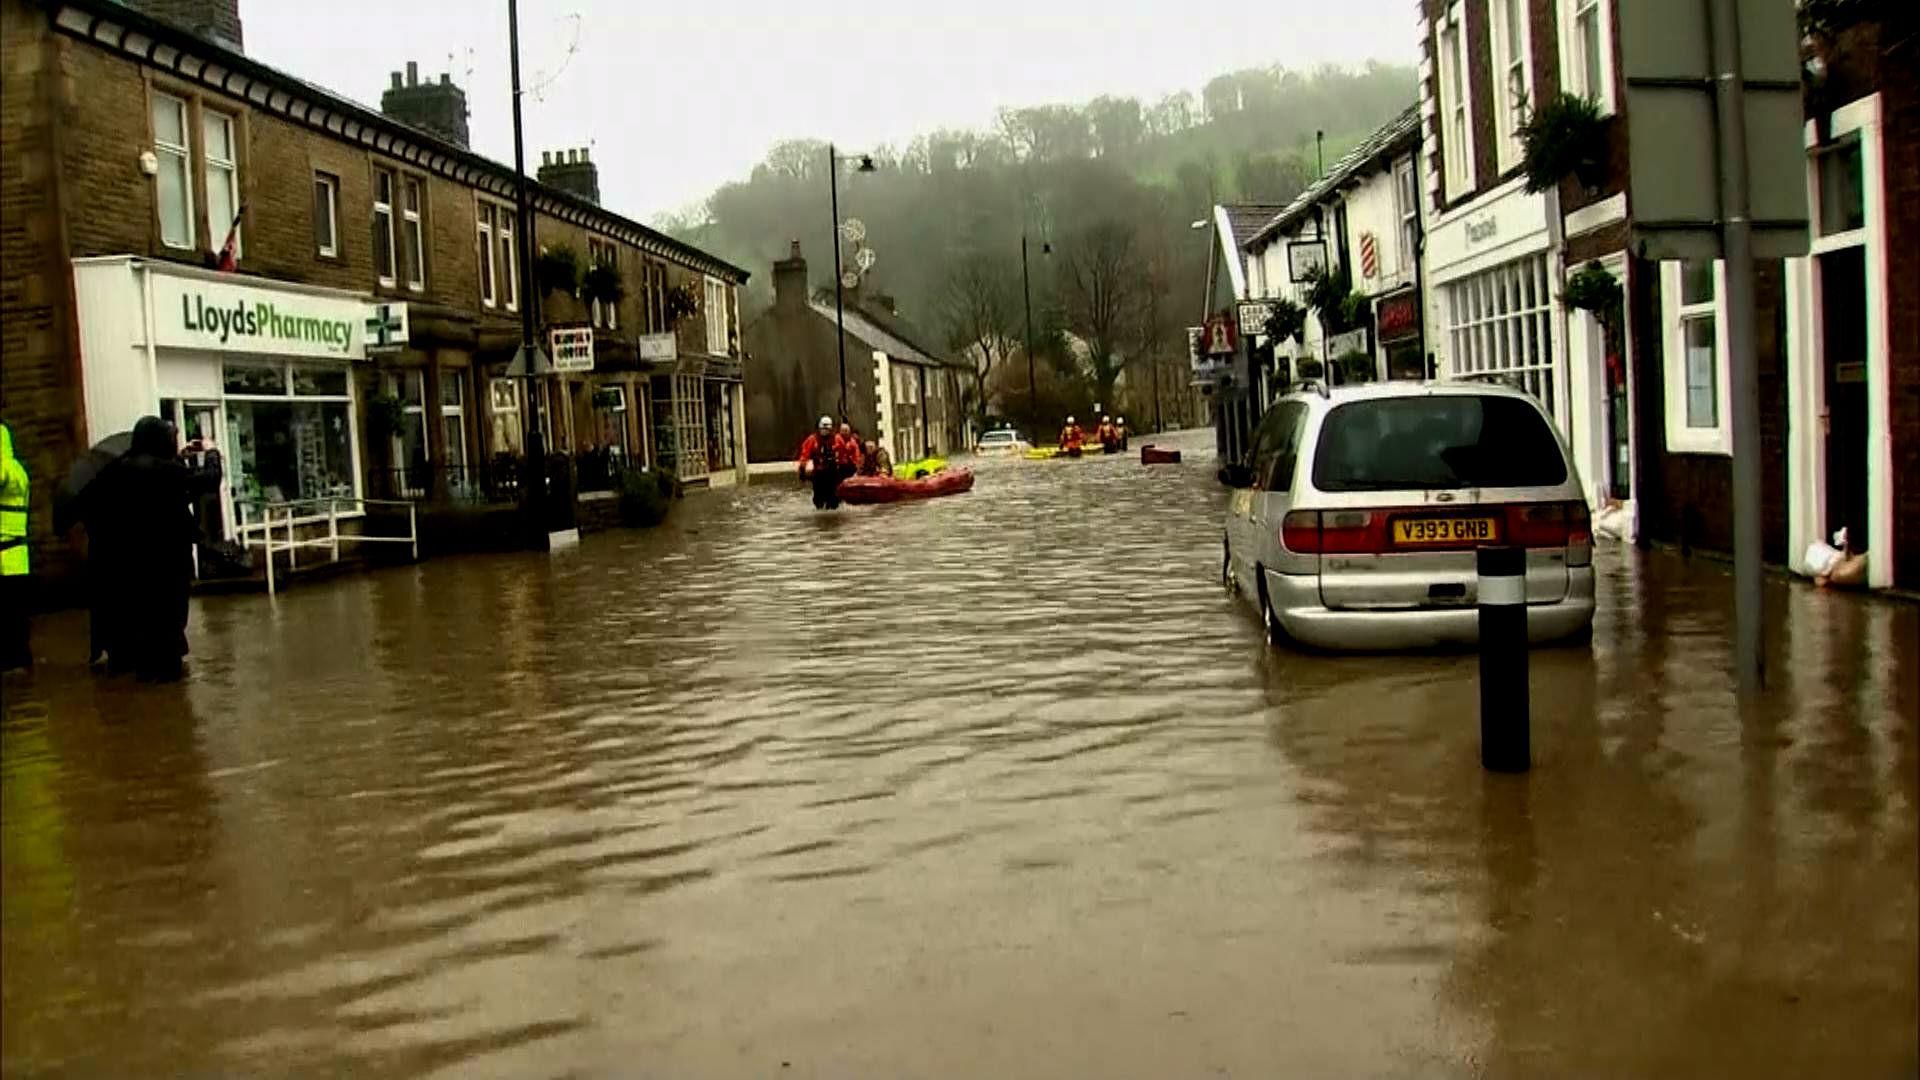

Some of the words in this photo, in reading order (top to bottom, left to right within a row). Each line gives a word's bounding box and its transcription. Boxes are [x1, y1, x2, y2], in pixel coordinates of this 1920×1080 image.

[183, 293, 352, 352] LloydsPharmacy
[1402, 521, 1450, 539] V393
[1453, 520, 1489, 538] GNB
